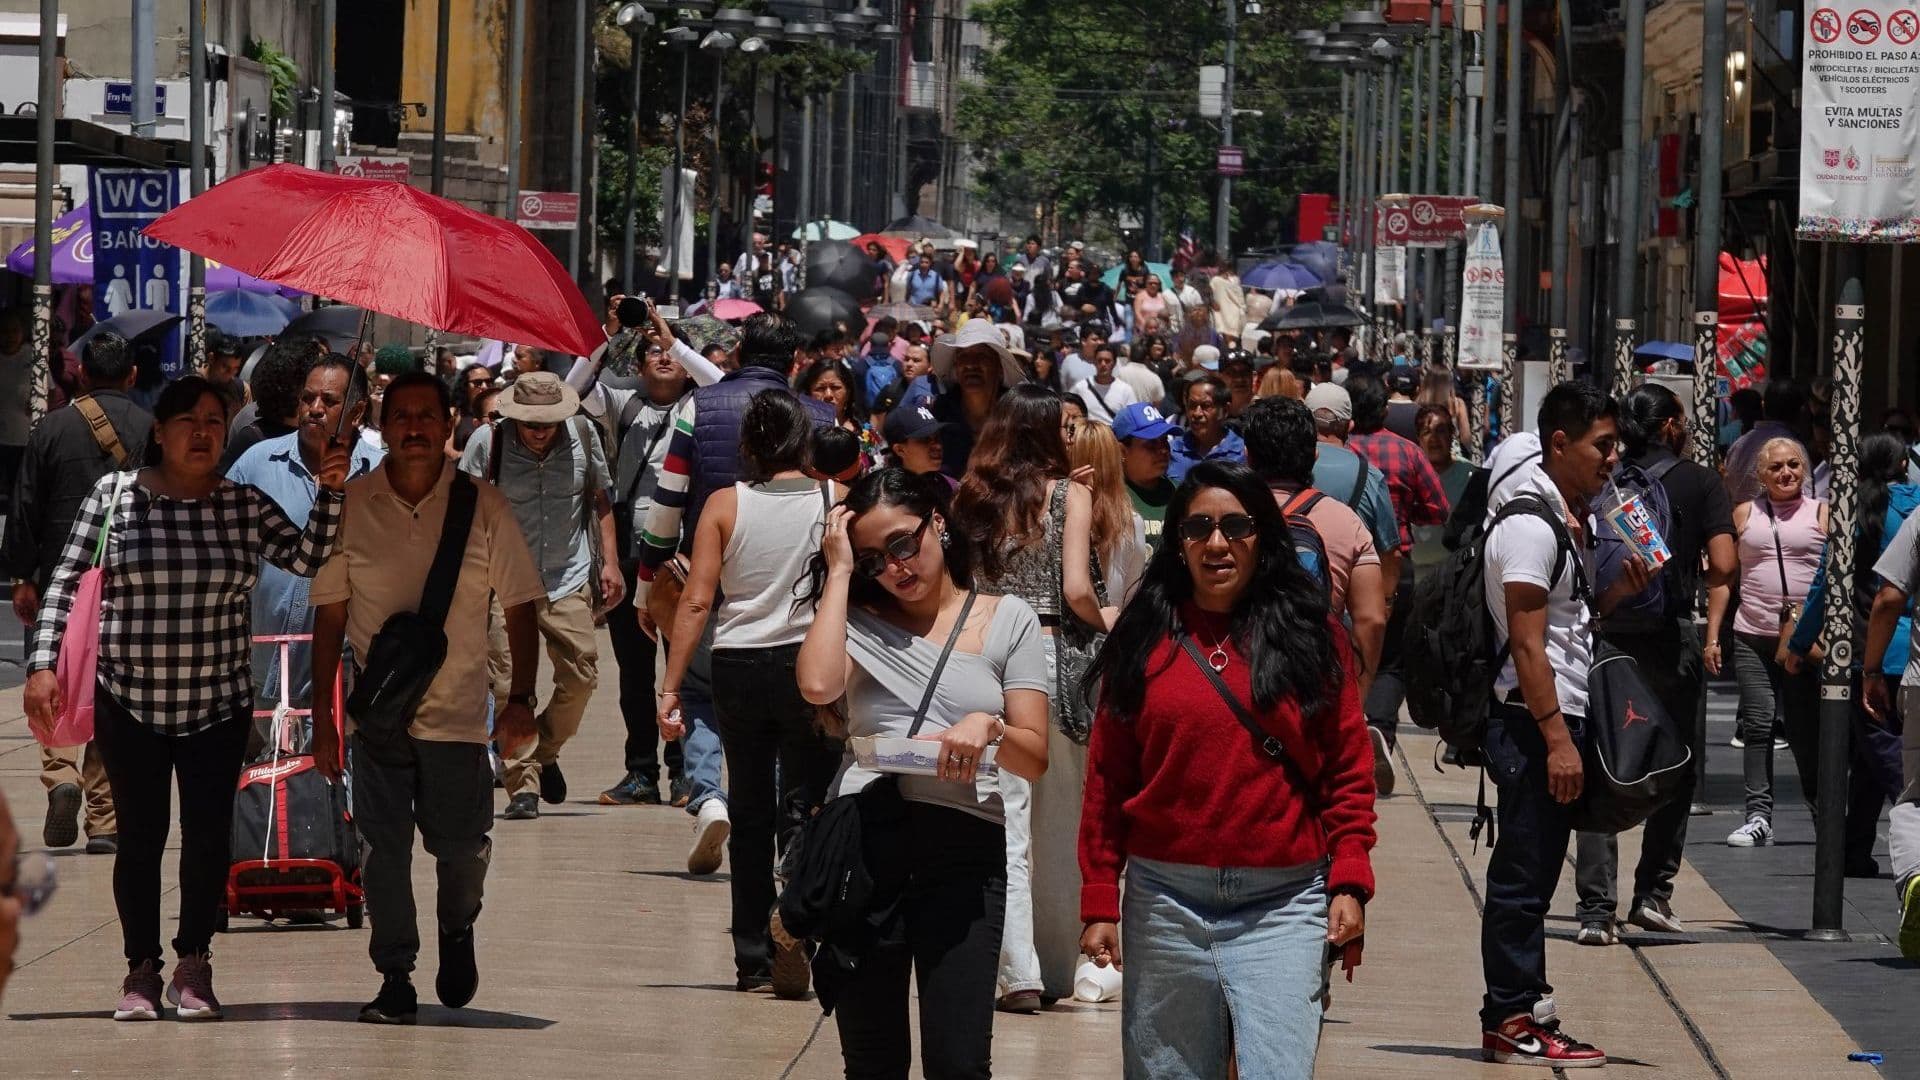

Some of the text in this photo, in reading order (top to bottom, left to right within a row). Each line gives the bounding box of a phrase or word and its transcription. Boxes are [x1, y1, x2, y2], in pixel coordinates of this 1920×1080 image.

[1808, 50, 1863, 60] PROHIBIDO
[1865, 51, 1877, 60] EL
[1881, 51, 1908, 60] PASO
[1809, 64, 1868, 73] MOTOCICLETAS
[1874, 66, 1920, 74] BICICLETAS
[1819, 74, 1910, 84] VEHÍCULOS ELÉCTRICOS
[1845, 86, 1887, 94] SCOOTERS
[1825, 106, 1903, 117] EVITA MULTAS
[1828, 118, 1900, 128] Y SANCIONES
[105, 178, 164, 208] WC
[101, 227, 171, 249] BAÑO
